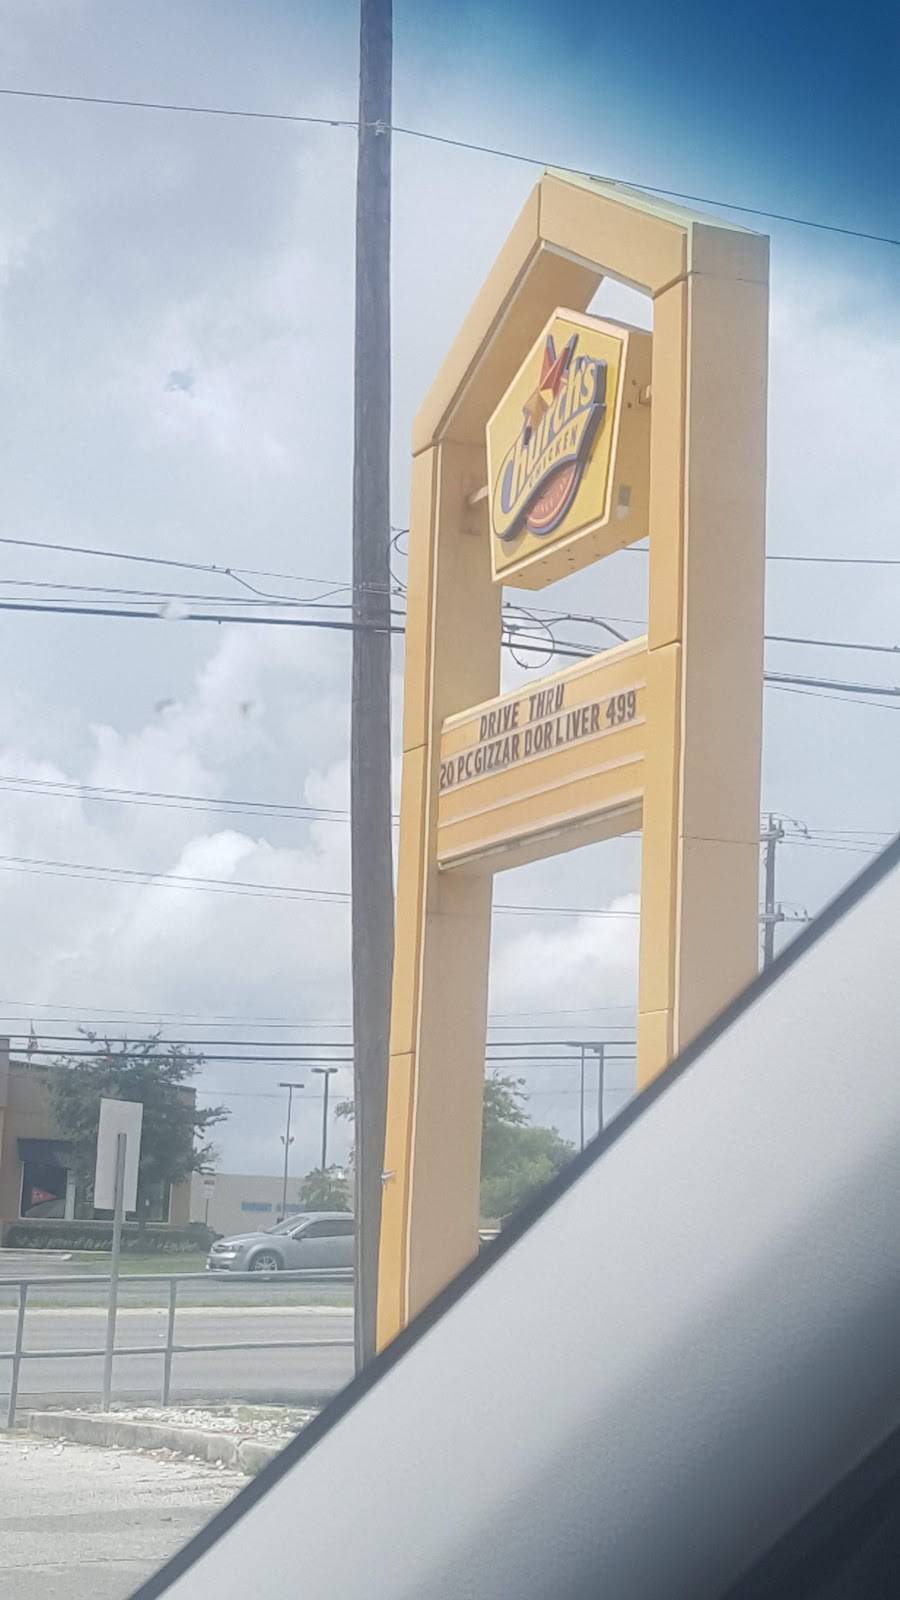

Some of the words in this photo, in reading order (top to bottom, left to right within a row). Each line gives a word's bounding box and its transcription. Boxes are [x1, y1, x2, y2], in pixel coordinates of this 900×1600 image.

[528, 424, 580, 489] CHICKEN
[480, 701, 520, 740] DRIVE
[528, 682, 565, 723] THRU
[605, 690, 637, 727] 499
